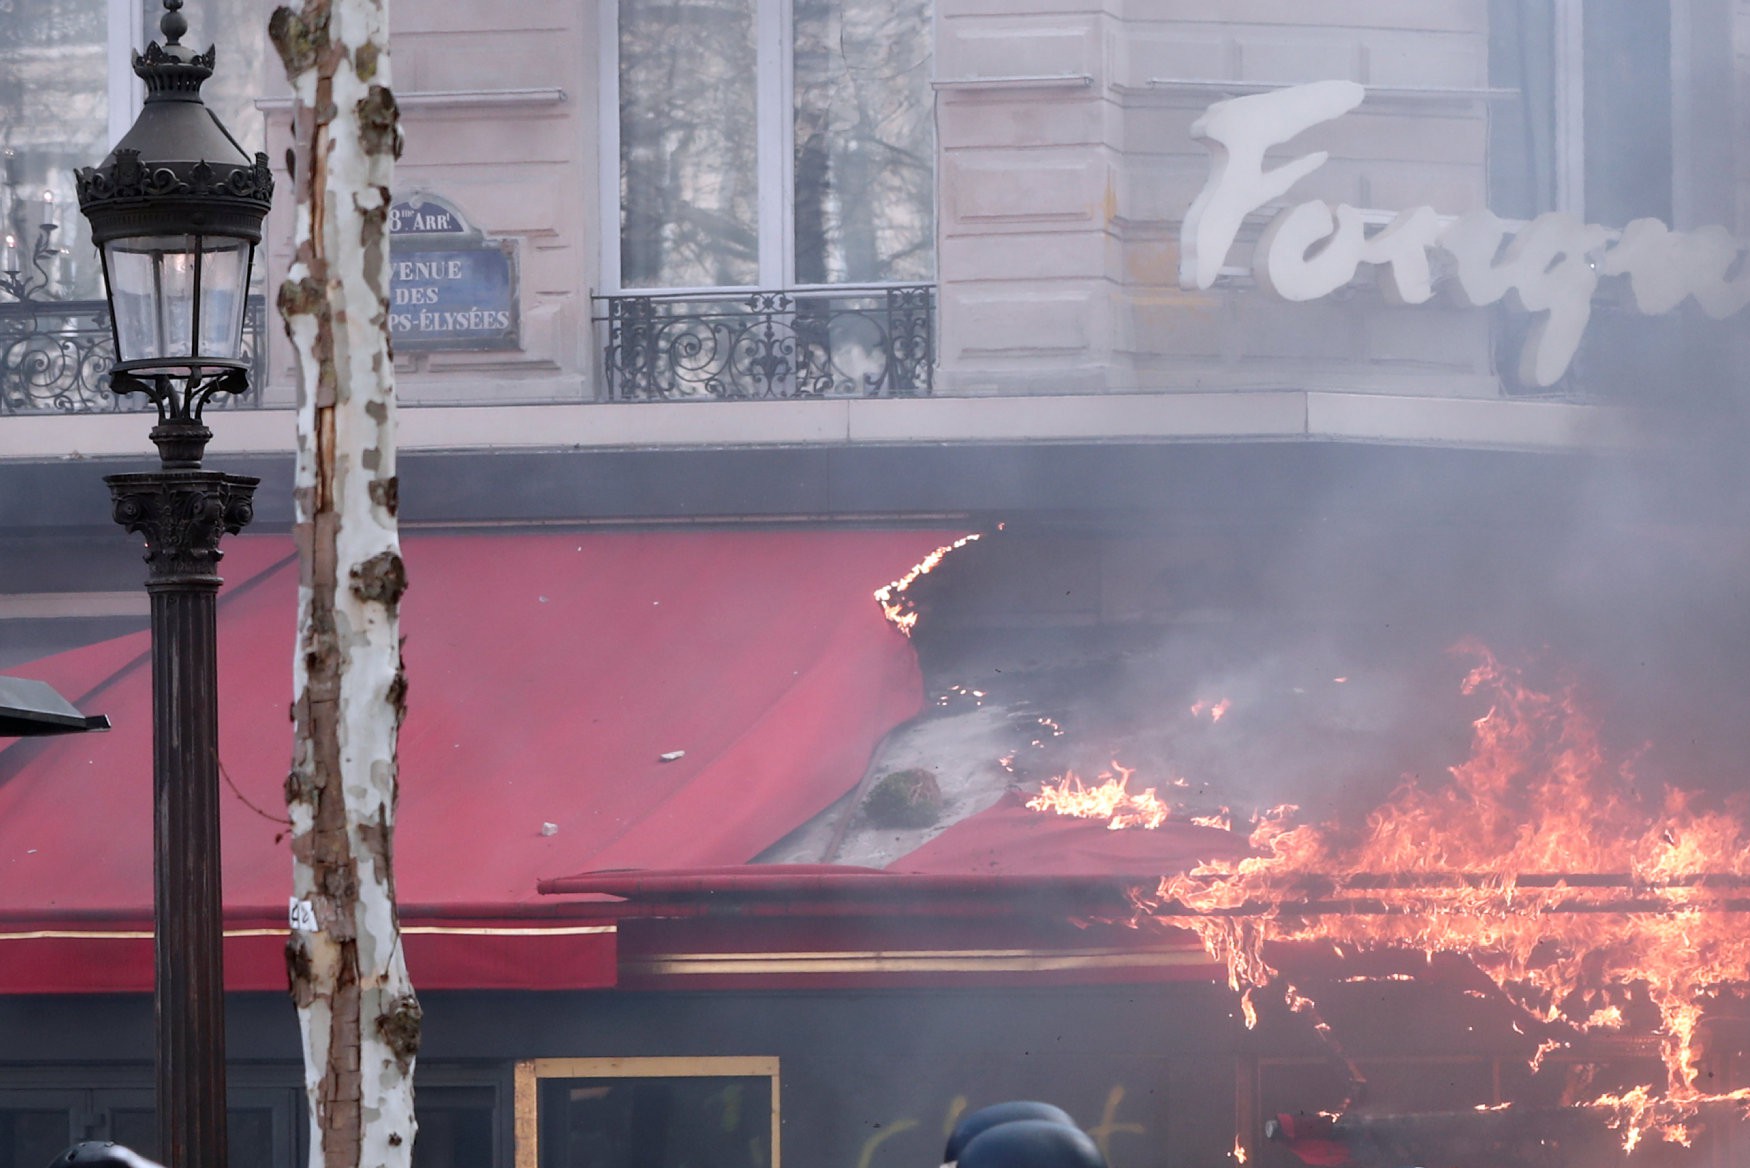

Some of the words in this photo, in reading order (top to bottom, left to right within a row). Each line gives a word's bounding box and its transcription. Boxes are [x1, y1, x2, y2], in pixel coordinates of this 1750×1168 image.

[390, 260, 462, 281] ENUE
[395, 287, 438, 304] DES
[389, 307, 509, 332] PS-ÉLYSÉES
